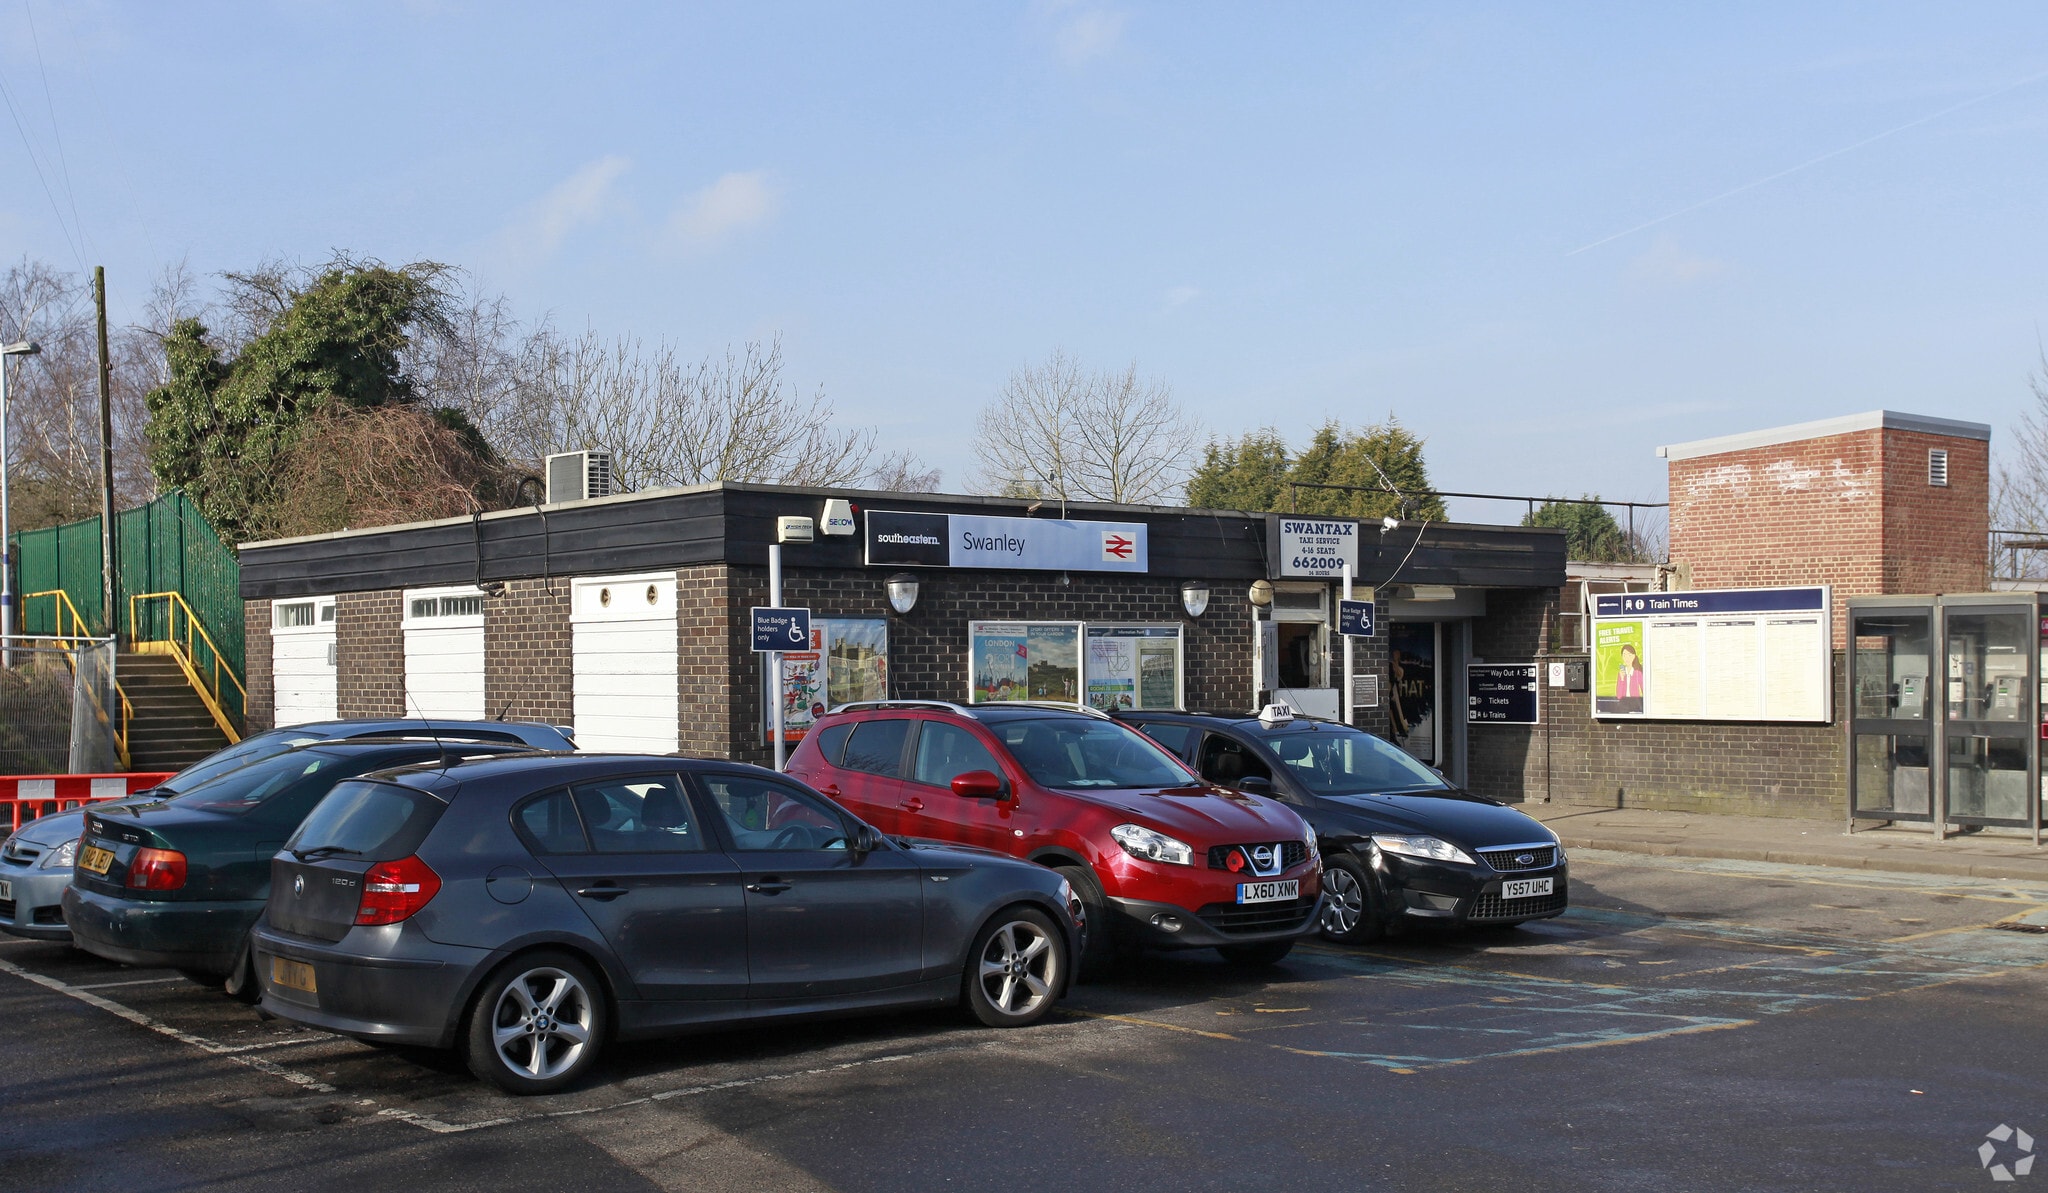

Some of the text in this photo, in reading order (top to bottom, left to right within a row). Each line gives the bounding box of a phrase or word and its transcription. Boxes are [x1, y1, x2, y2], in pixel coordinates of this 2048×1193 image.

[829, 518, 853, 526] SECOM
[1284, 522, 1353, 536] SWANTAX
[963, 531, 1026, 557] Swanley
[1299, 536, 1340, 545] TAXI SERVICE
[1316, 547, 1336, 555] SEATS
[1292, 556, 1345, 569] 662009
[1649, 598, 1699, 609] Train Times
[757, 616, 788, 625] Blue Badge
[757, 625, 778, 633] holders
[1598, 626, 1634, 637] FREE TRAVEL
[757, 634, 770, 642] only
[1599, 635, 1620, 644] ALERTS
[984, 639, 1015, 647] LONDON
[1490, 669, 1515, 678] Way Out
[1497, 683, 1515, 691] Buses
[1488, 697, 1509, 705] Tickets
[1271, 705, 1290, 717] TAXI
[1488, 711, 1506, 719] Trains
[1244, 881, 1298, 900] LX60 XNK
[1506, 880, 1550, 896] YS57 UHC
